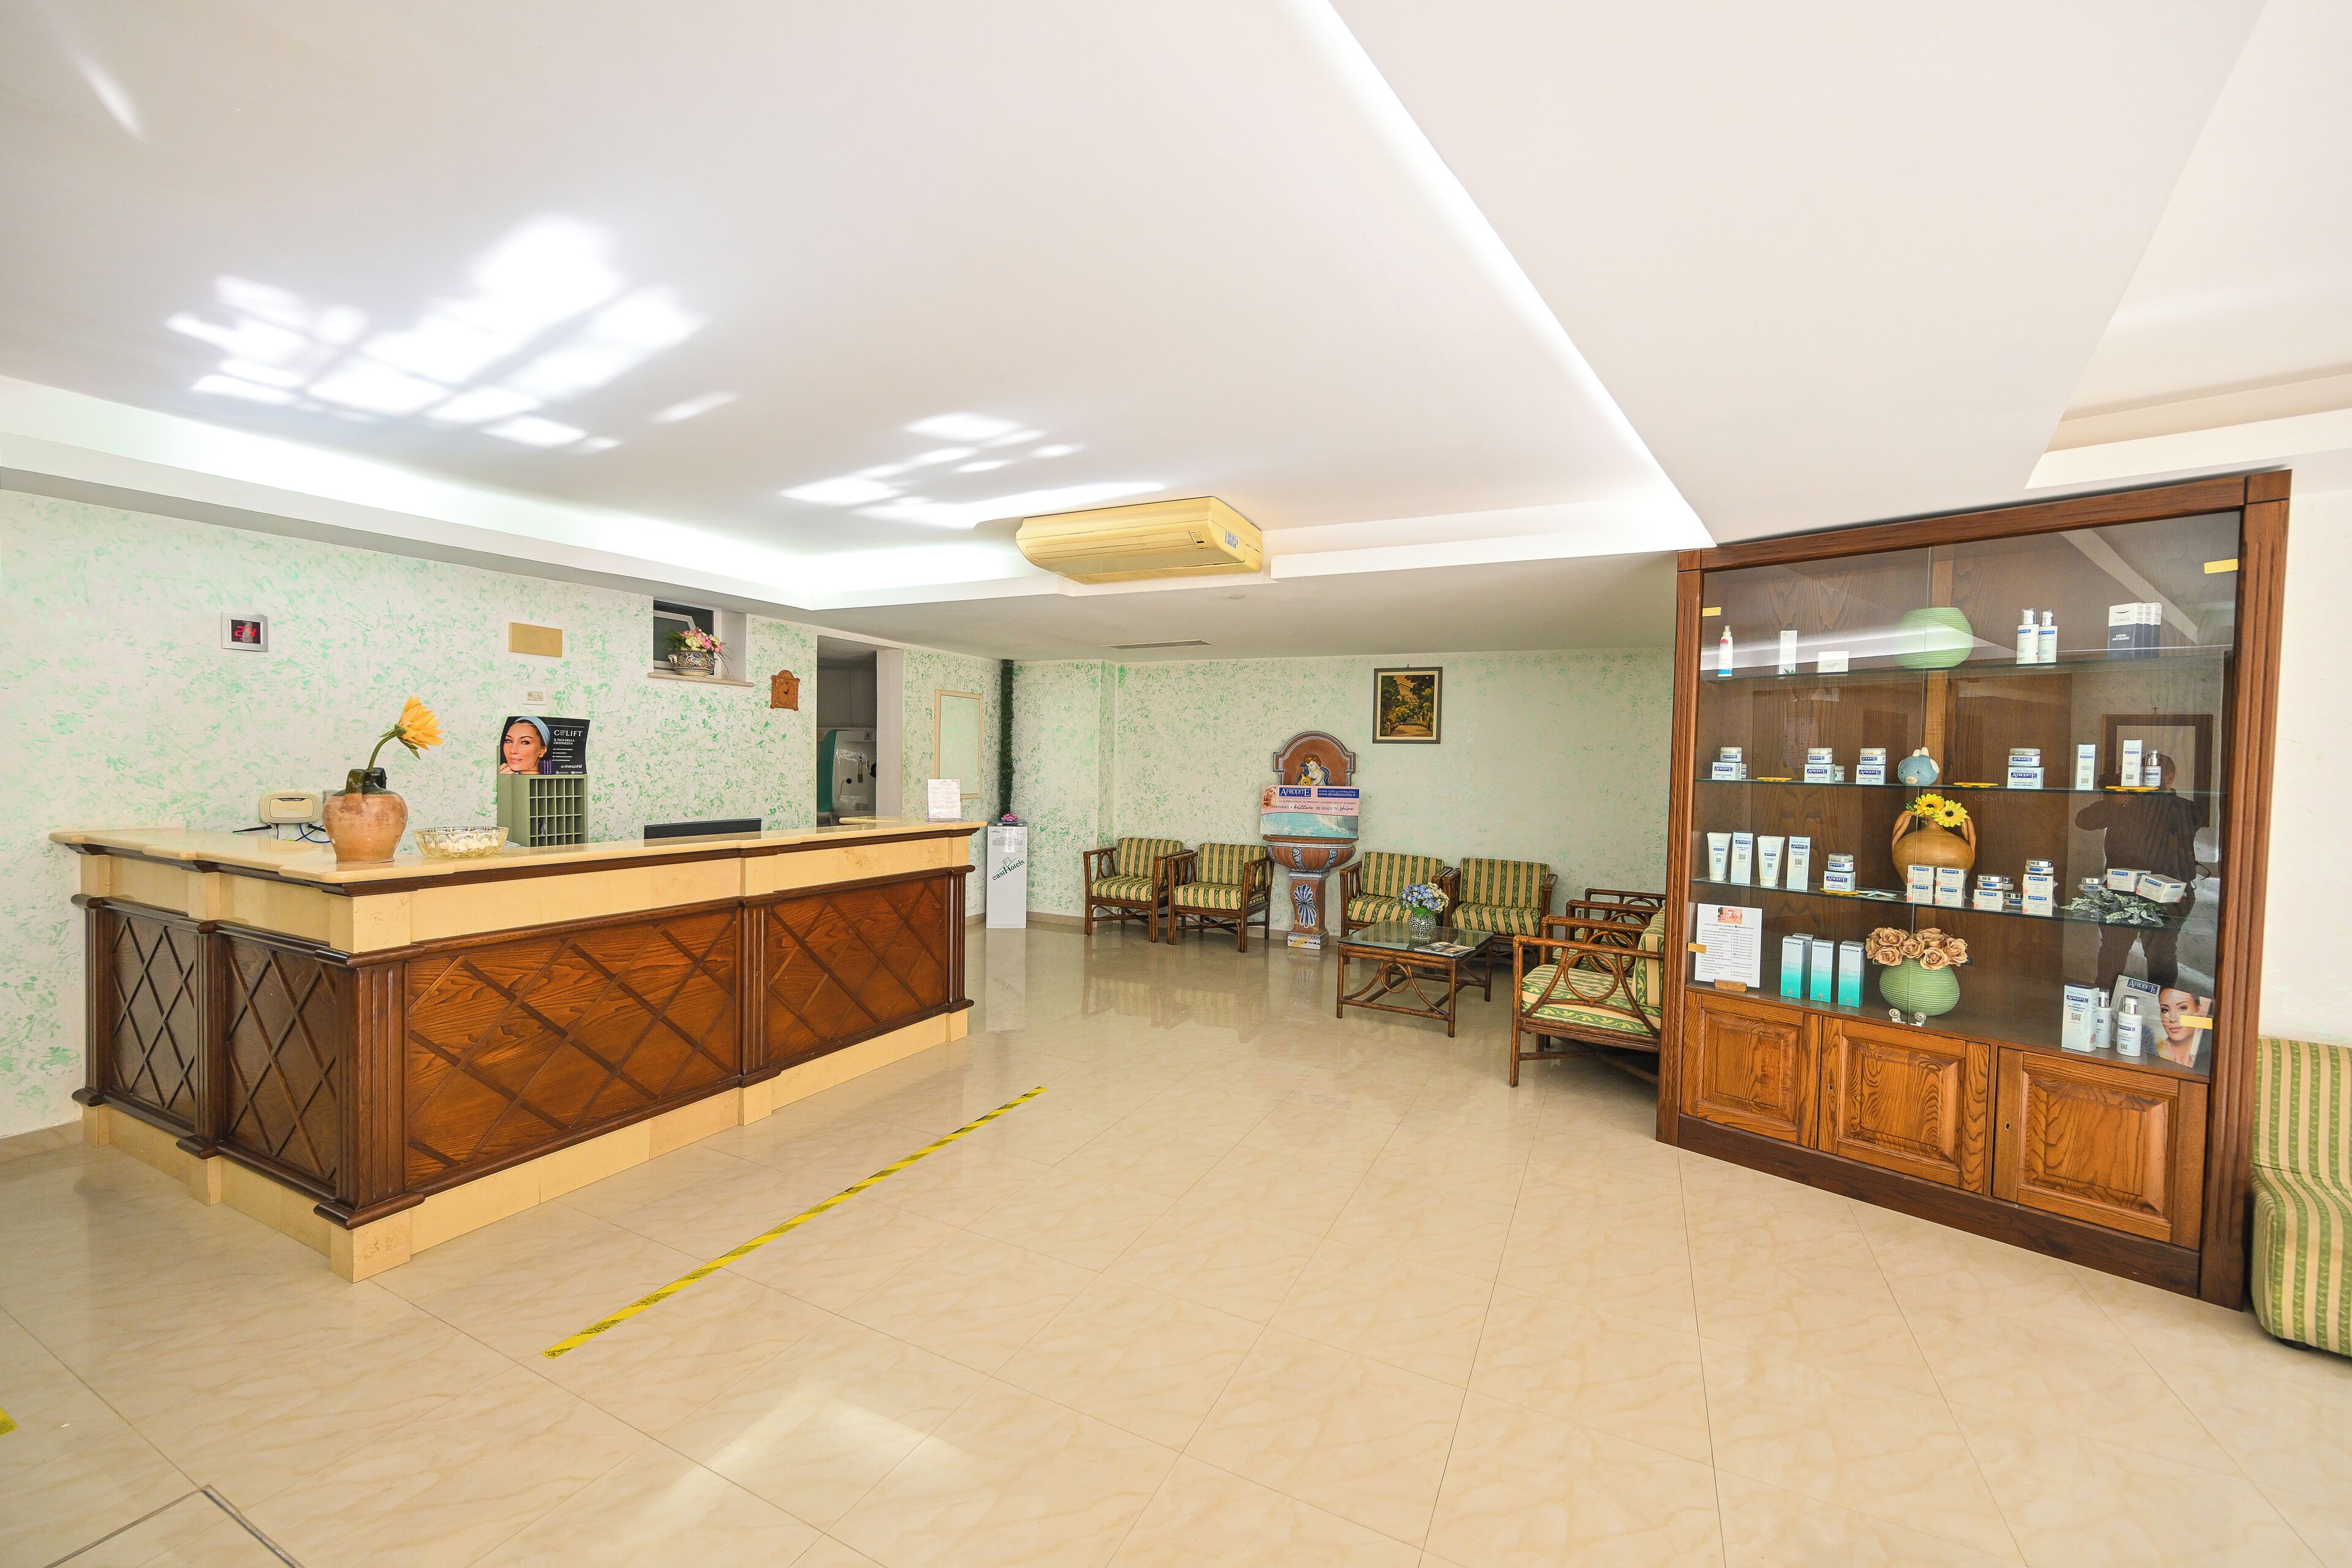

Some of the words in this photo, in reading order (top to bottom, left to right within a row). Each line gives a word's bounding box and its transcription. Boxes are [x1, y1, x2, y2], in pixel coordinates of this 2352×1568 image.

[234, 625, 257, 637] 24
[1280, 788, 1311, 796] AFRODITE
[992, 859, 1025, 881] eastHotels
[2128, 979, 2157, 993] AFRODITE
